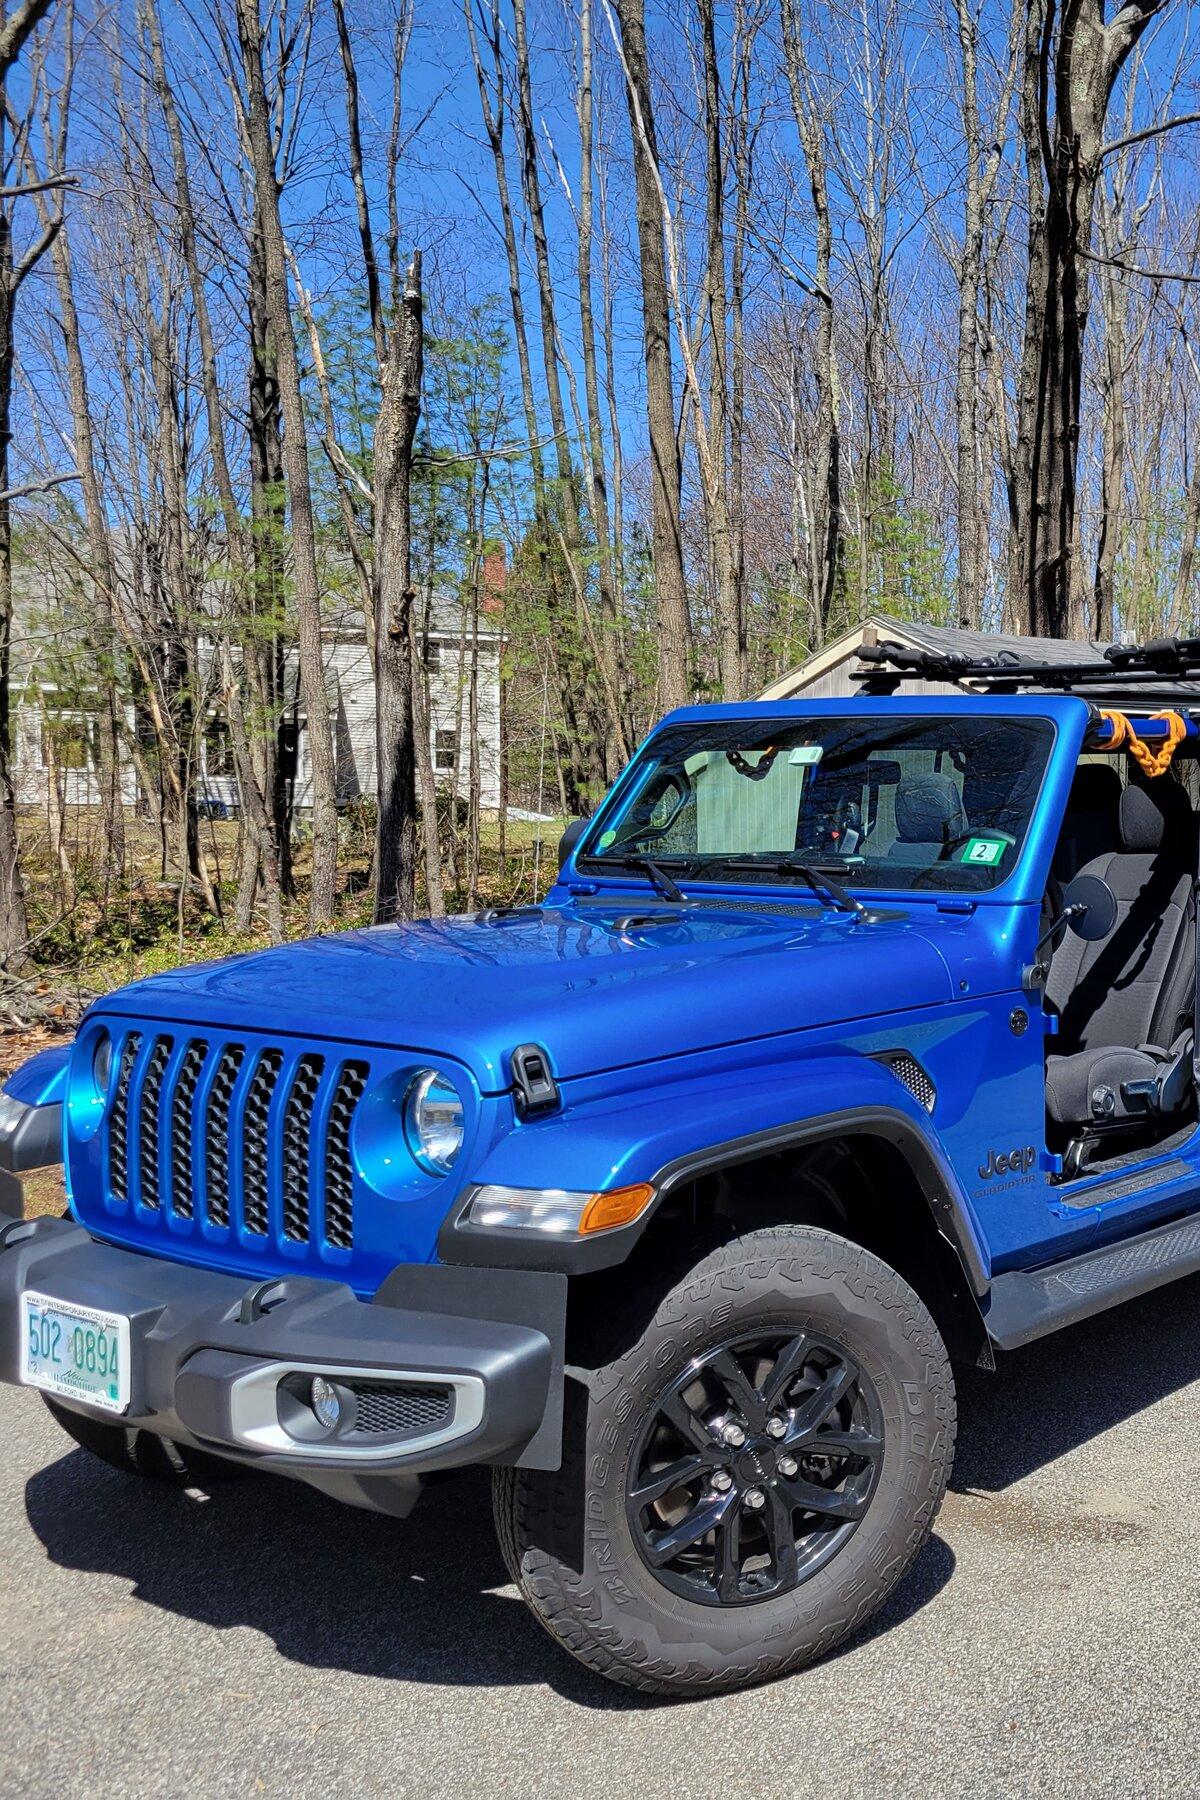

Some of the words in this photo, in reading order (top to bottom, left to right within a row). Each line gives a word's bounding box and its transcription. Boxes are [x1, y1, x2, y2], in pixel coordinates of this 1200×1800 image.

[976, 844, 988, 858] 2
[978, 1146, 1036, 1179] Jeep
[29, 1313, 63, 1363] 502
[73, 1326, 118, 1381] 0894
